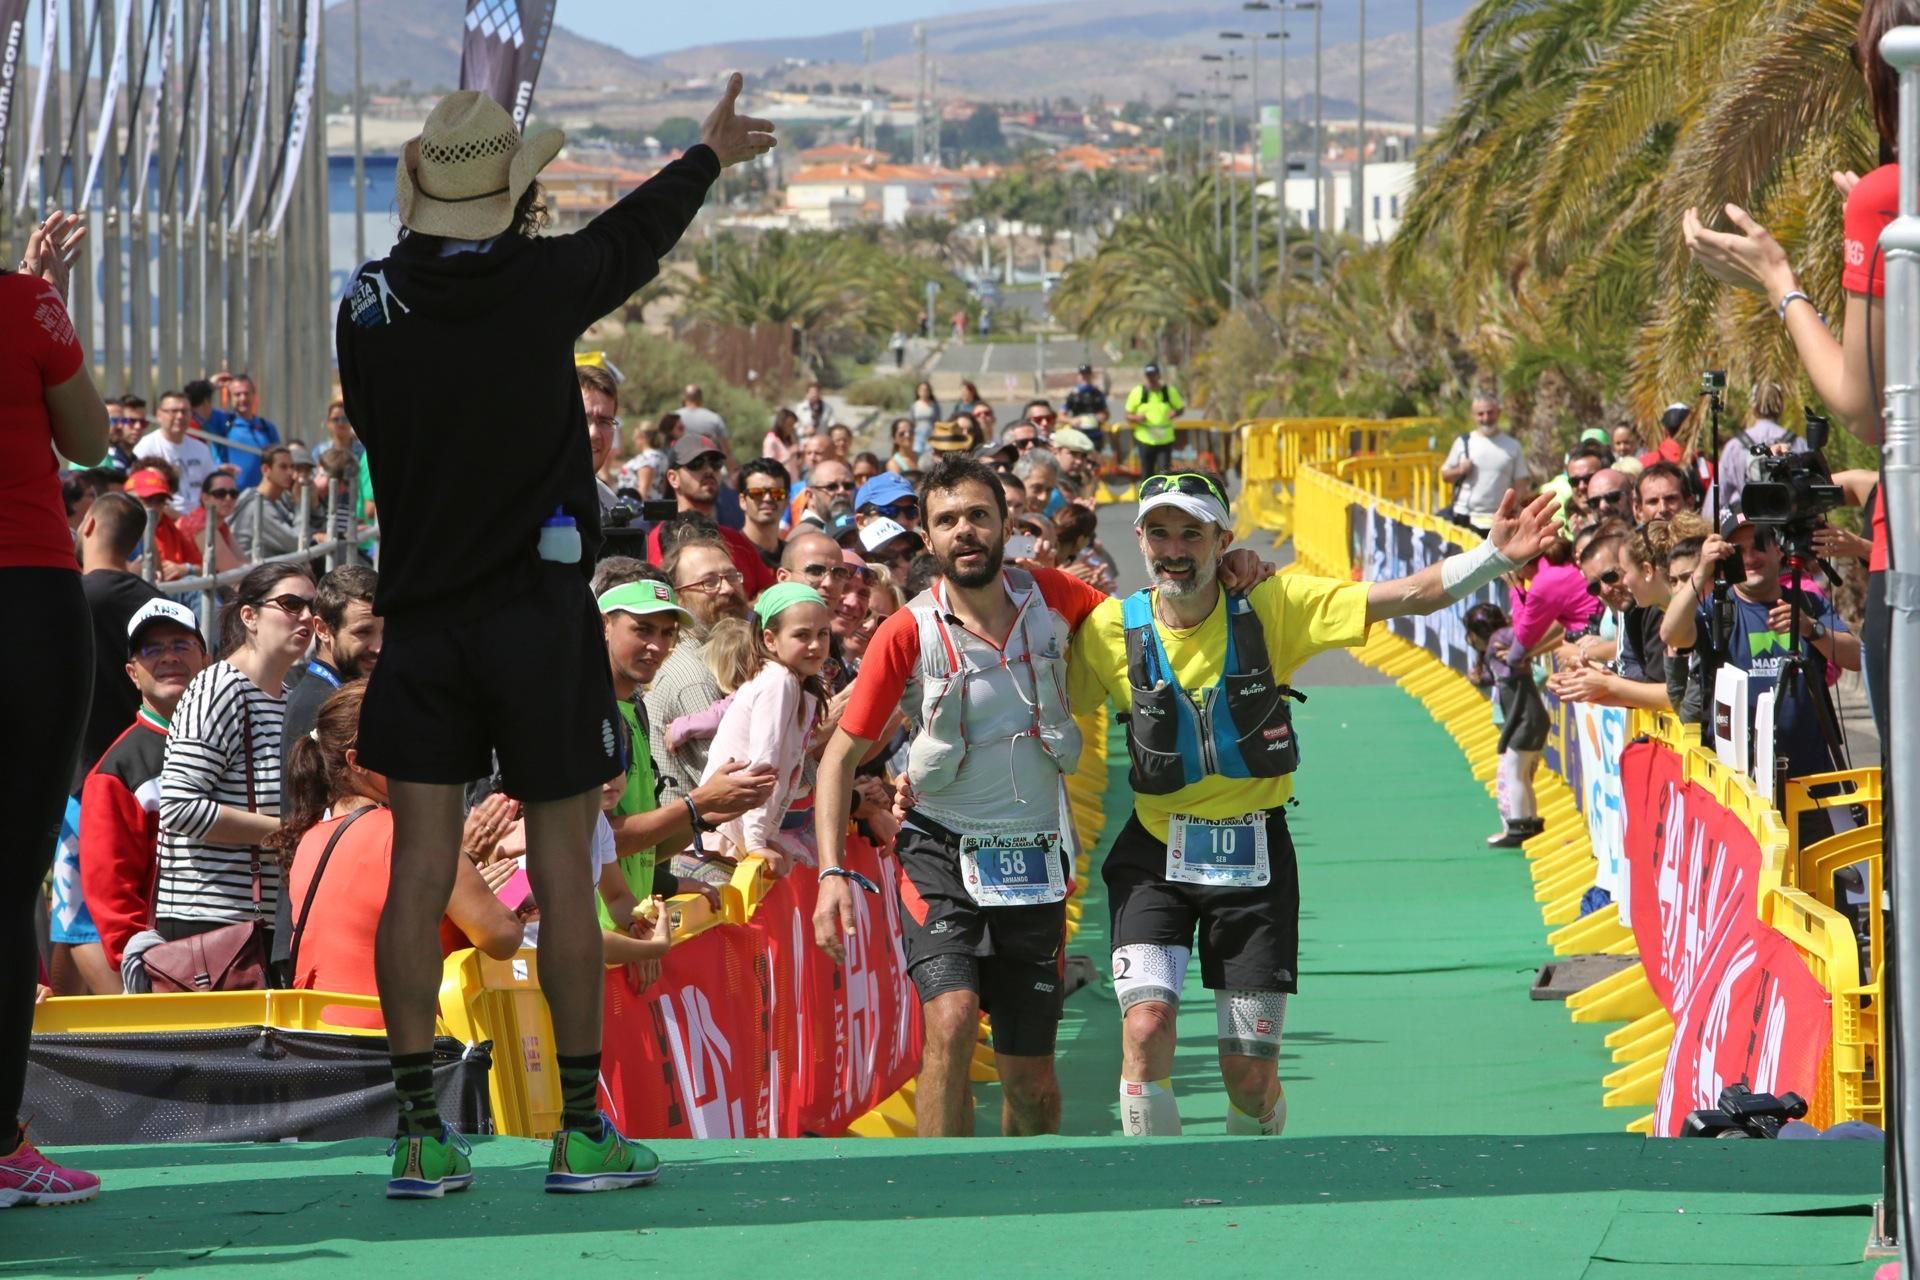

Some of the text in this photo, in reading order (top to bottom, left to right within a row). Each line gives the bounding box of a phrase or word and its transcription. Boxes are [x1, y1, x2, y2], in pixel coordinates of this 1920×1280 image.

[979, 835, 1012, 848] TRANS
[1209, 828, 1236, 854] 10
[1000, 850, 1027, 875] 58
[1215, 855, 1227, 863] SEB
[1002, 875, 1028, 884] ARMANDO
[829, 998, 844, 1121] SPORT
[755, 1079, 769, 1137] RT
